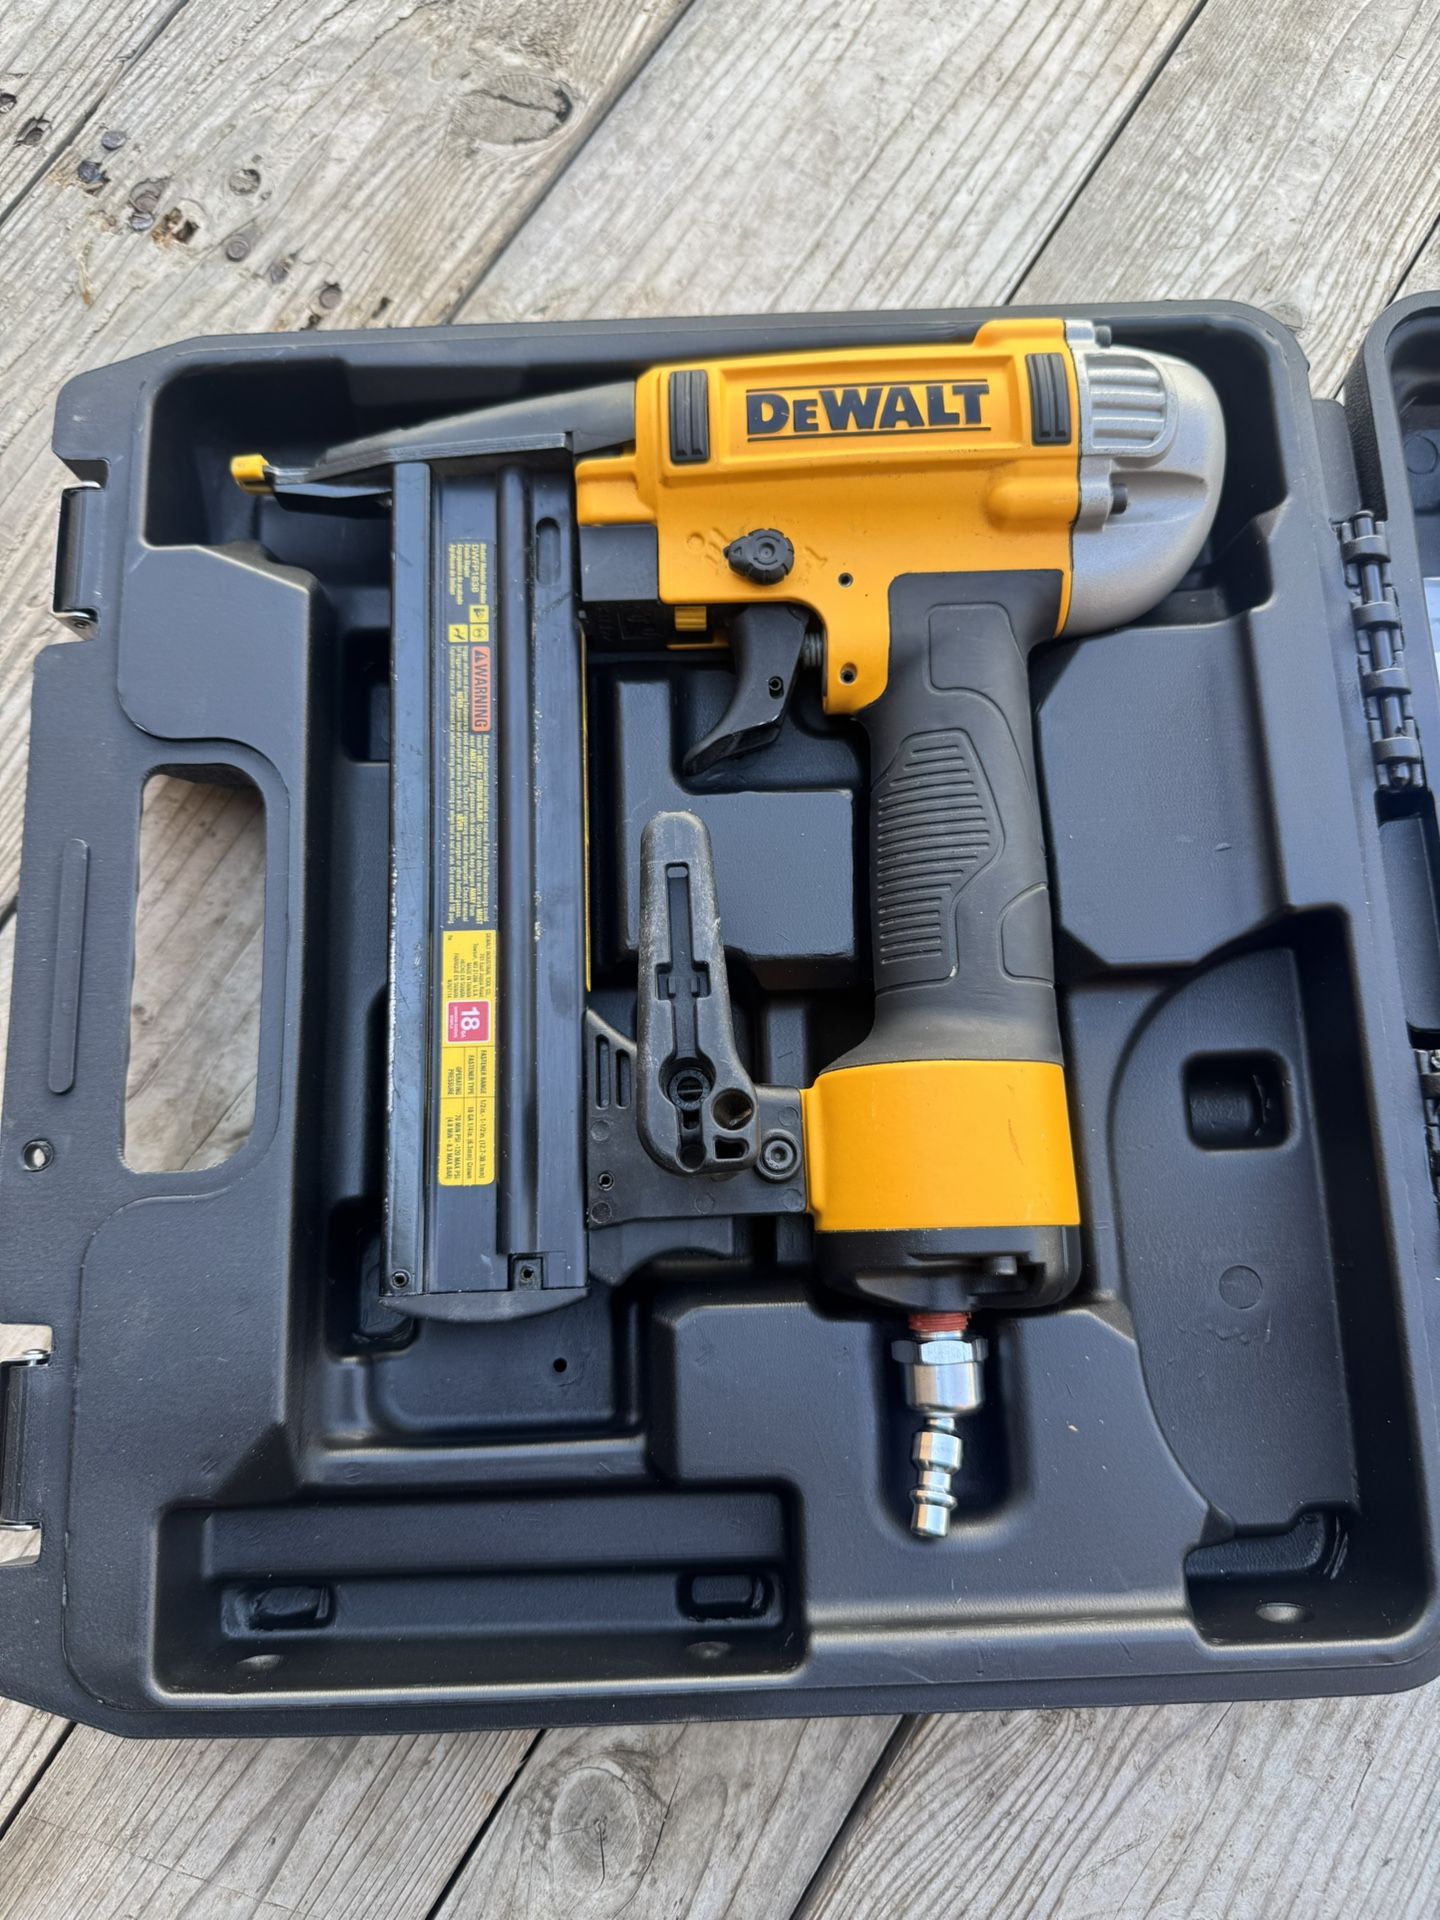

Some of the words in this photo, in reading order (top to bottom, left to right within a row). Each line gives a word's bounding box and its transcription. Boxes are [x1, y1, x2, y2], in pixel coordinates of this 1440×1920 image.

[472, 544, 480, 592] DWFP1838
[474, 664, 488, 728] WARNING
[461, 1006, 480, 1030] 18
